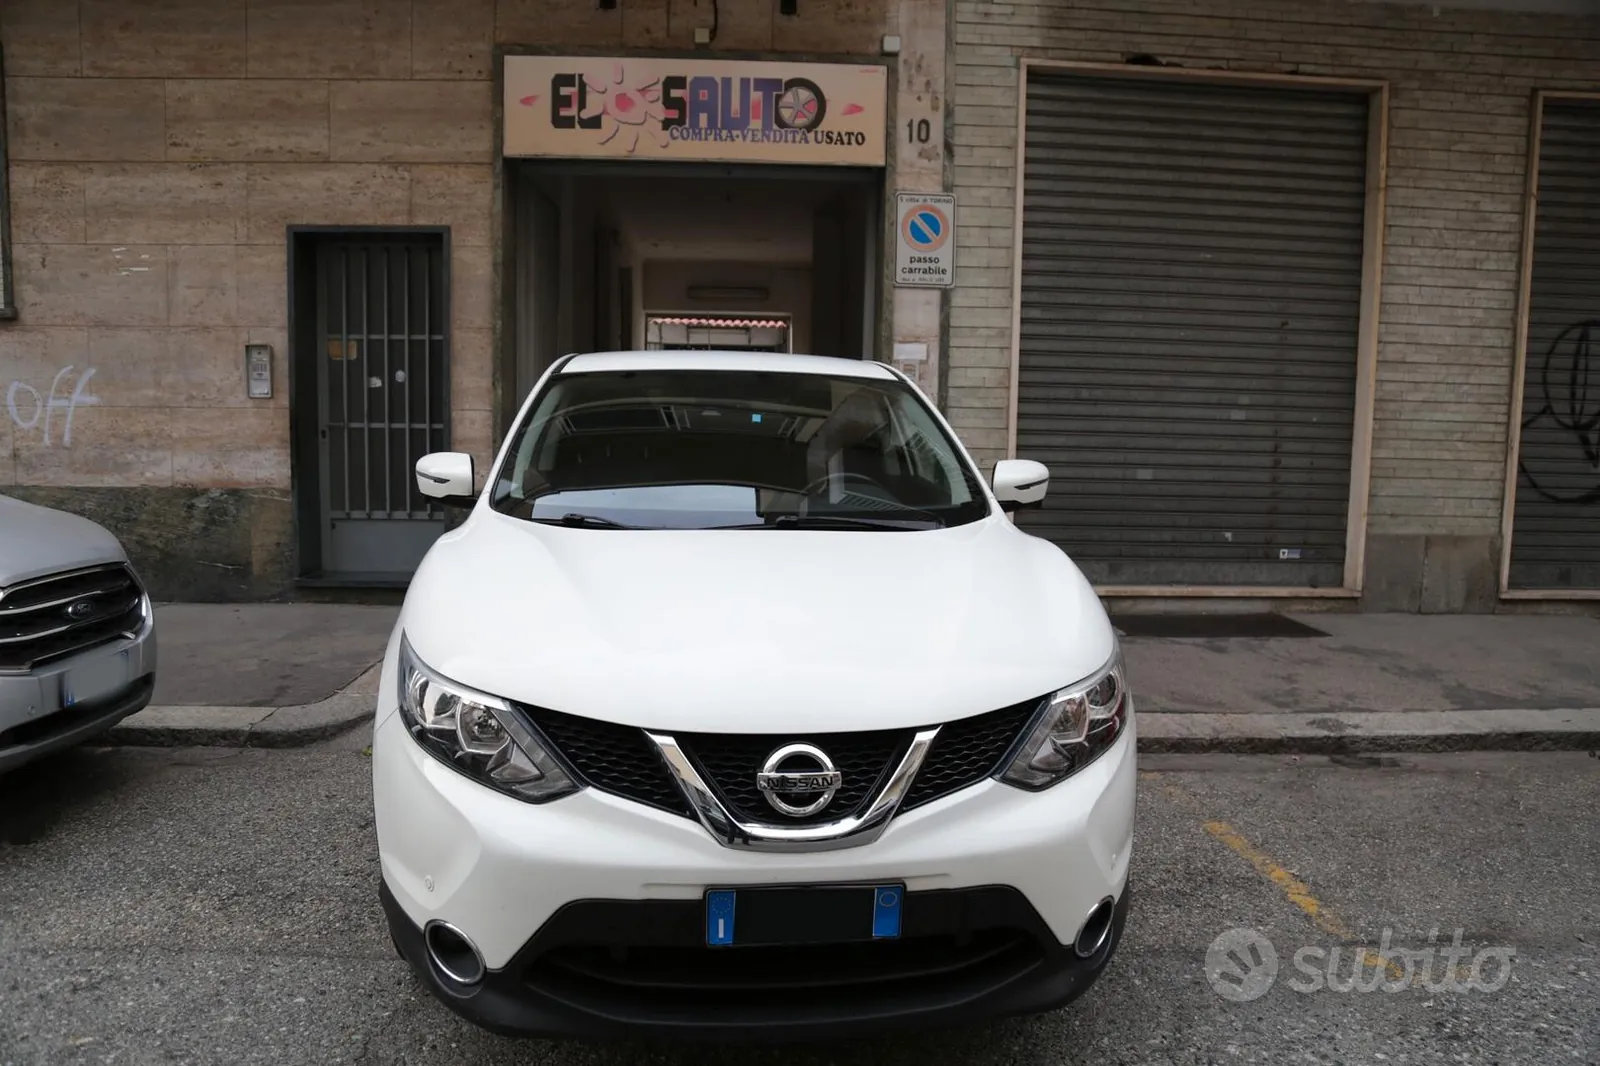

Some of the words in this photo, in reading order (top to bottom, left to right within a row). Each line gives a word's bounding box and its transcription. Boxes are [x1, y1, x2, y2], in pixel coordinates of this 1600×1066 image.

[906, 118, 930, 144] 10
[814, 131, 866, 146] USATO
[909, 256, 940, 264] passo
[901, 266, 947, 275] carrabile
[767, 776, 834, 789] NISSAN
